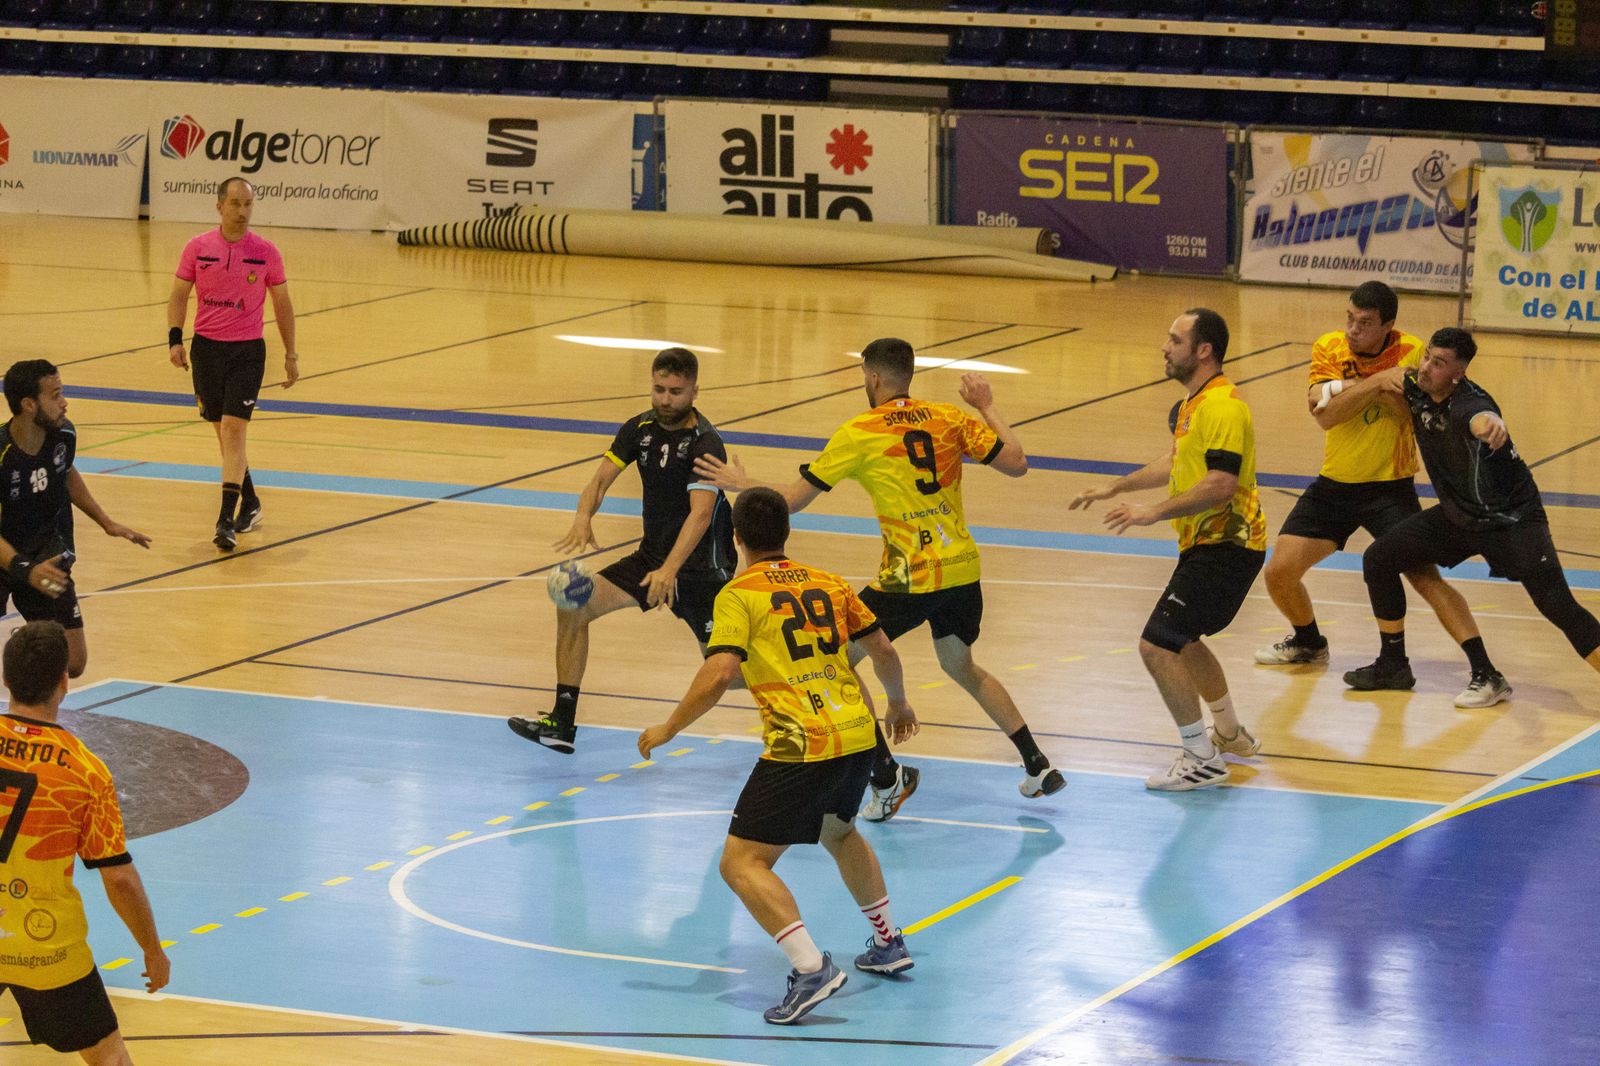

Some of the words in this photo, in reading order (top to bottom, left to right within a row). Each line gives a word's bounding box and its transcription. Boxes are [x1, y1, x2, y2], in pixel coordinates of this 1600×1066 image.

[205, 118, 380, 173] algetoner
[719, 113, 794, 178] ali
[1045, 134, 1135, 149] CADENA
[33, 150, 119, 167] LIONZAMAR
[467, 178, 554, 196] SEAT
[1019, 149, 1160, 205] SER
[284, 186, 316, 202] para
[318, 183, 330, 200] la
[332, 185, 379, 201] oficina
[977, 210, 1018, 228] Radio
[1166, 235, 1189, 247] 1260
[1168, 246, 1189, 257] 93.0
[1191, 247, 1207, 258] FM
[1280, 254, 1308, 268] CLUB
[1311, 255, 1386, 272] BALONMANO
[1388, 260, 1433, 275] CIUDAD
[1435, 263, 1450, 276] DE
[1498, 265, 1552, 288] Con
[1560, 269, 1586, 290] el
[1522, 298, 1557, 319] de
[883, 407, 933, 426] SERVANT
[660, 443, 670, 468] 3
[903, 430, 942, 495] 9
[764, 568, 811, 585] FERRER
[770, 587, 840, 662] 29
